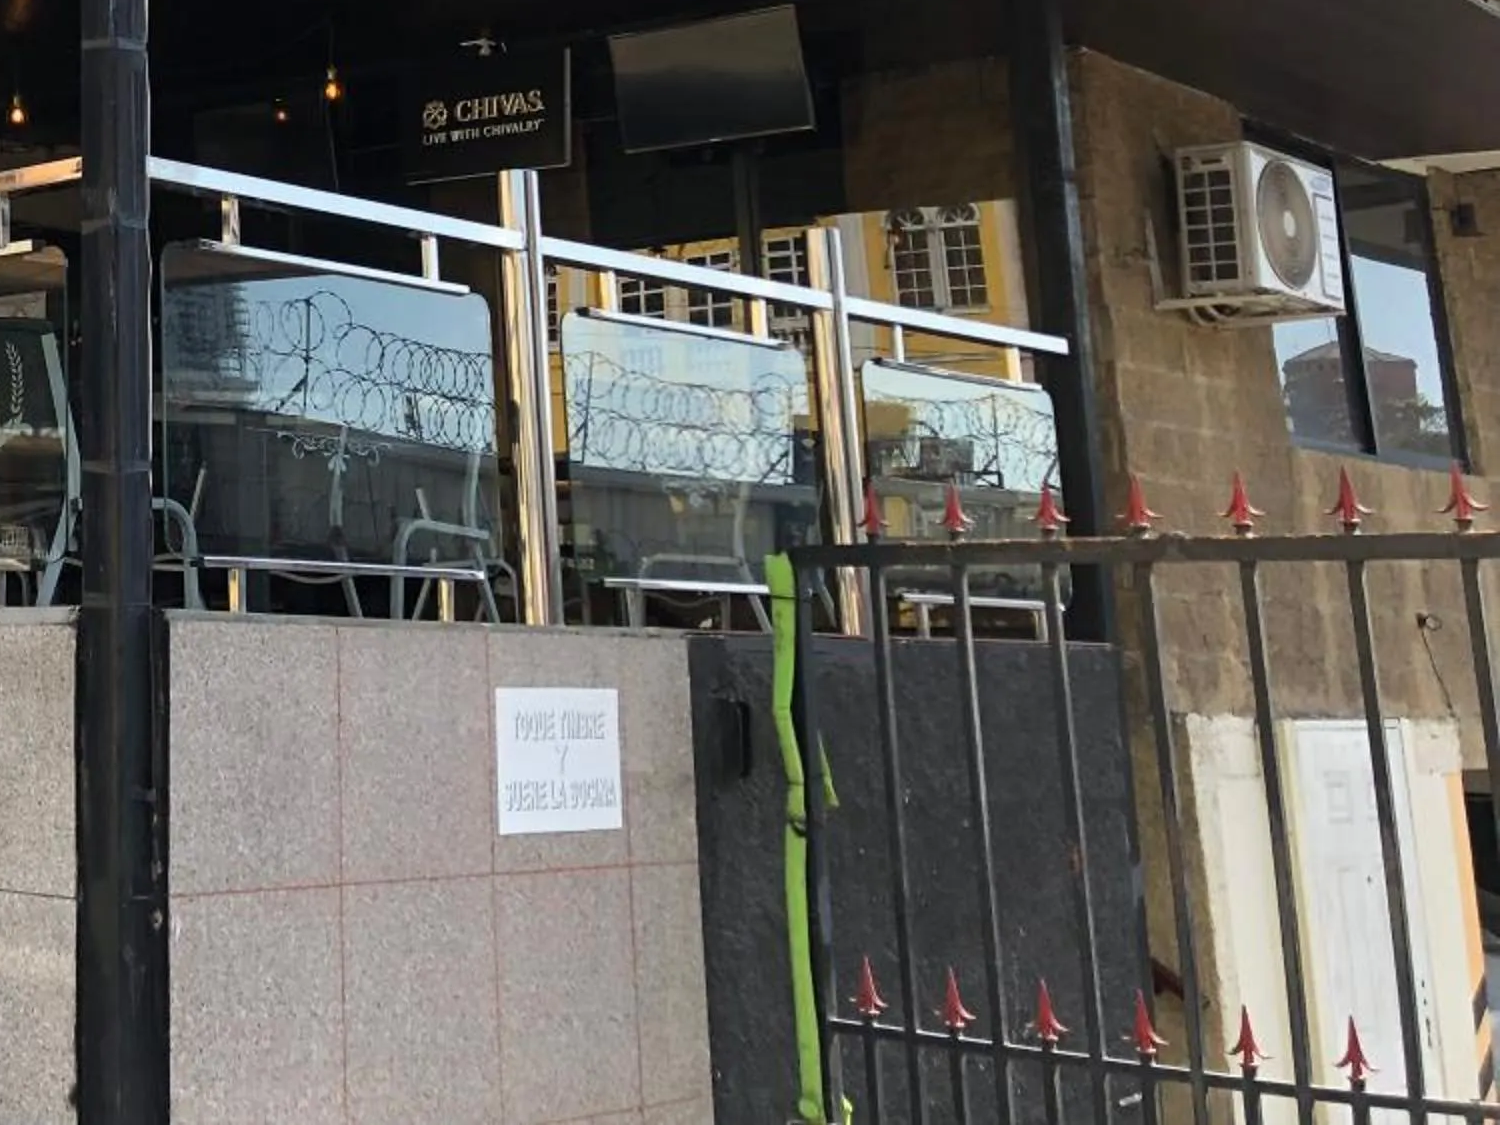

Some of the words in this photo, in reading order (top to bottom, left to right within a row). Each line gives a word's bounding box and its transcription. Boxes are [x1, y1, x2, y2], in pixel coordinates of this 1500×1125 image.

[454, 89, 545, 123] CHIVAS
[422, 132, 447, 146] LIVE
[449, 127, 480, 142] WITH
[482, 119, 541, 138] CHIVALRY
